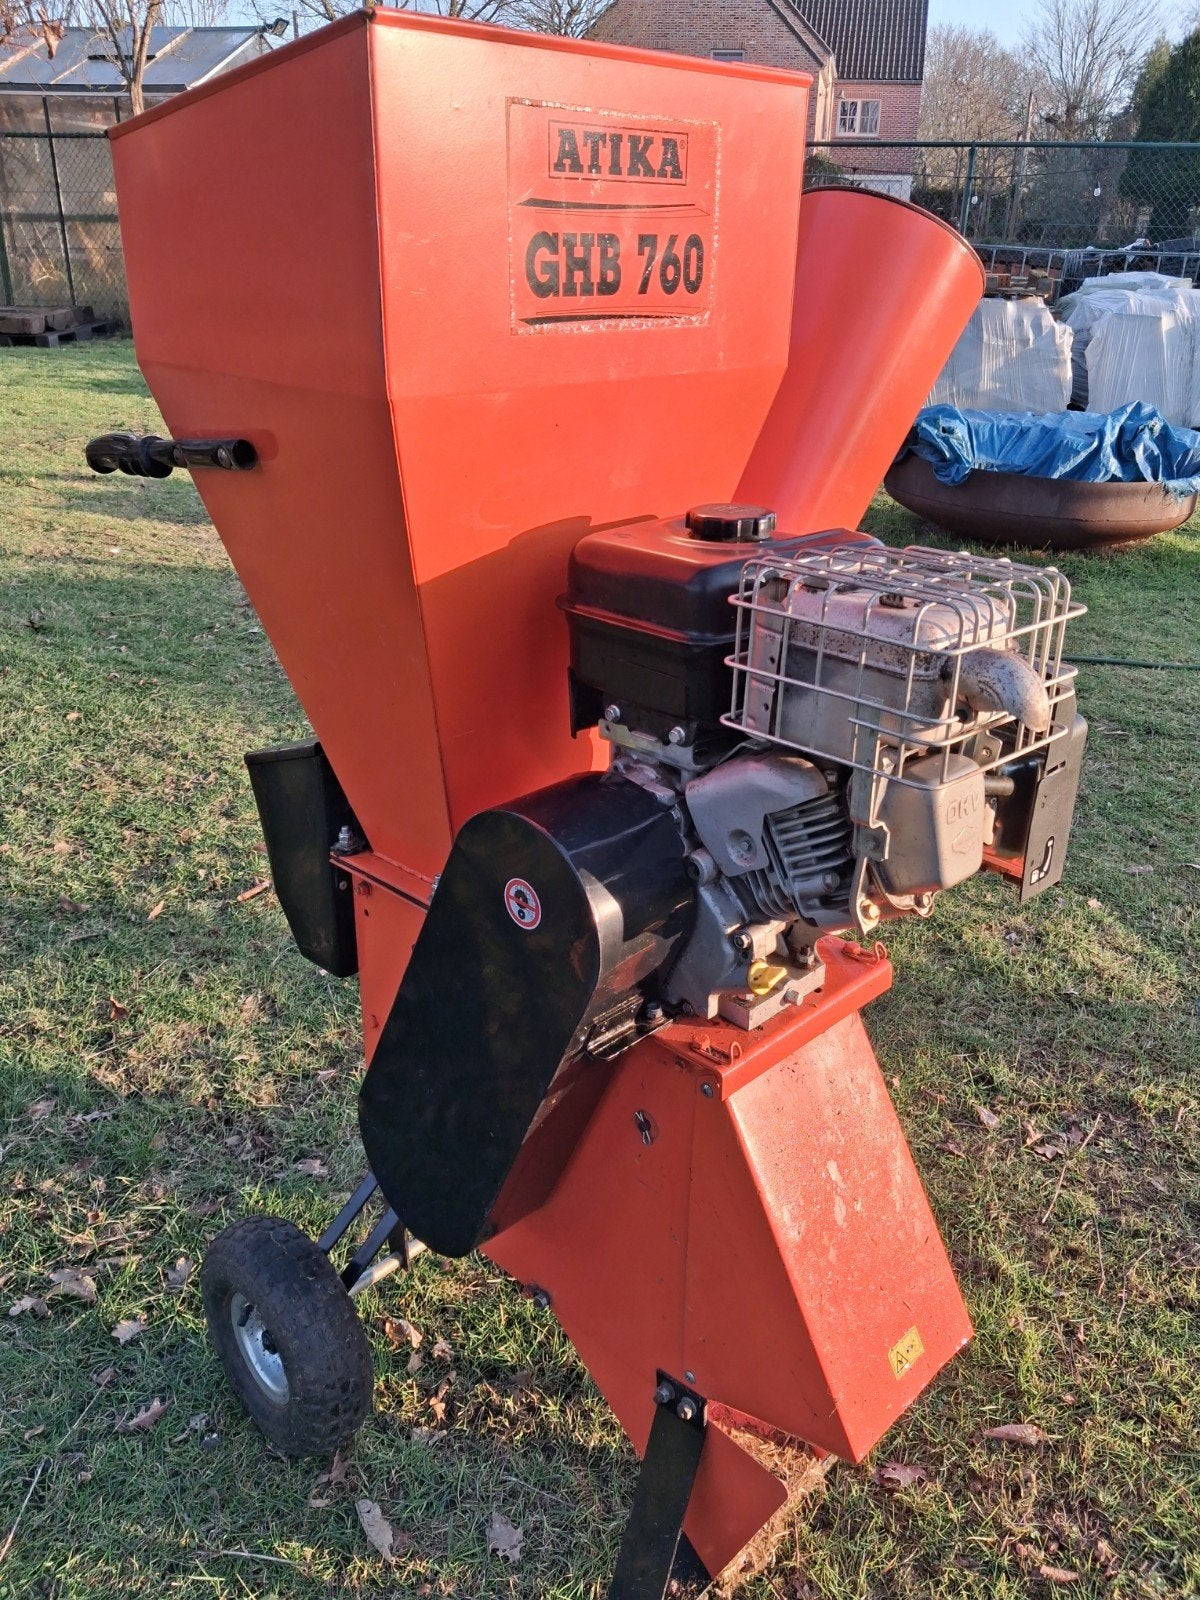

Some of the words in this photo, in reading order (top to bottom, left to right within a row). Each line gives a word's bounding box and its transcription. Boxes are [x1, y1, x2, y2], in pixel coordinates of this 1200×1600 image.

[553, 128, 684, 180] ATIKA
[525, 231, 622, 298] GHB
[637, 233, 704, 295] 760
